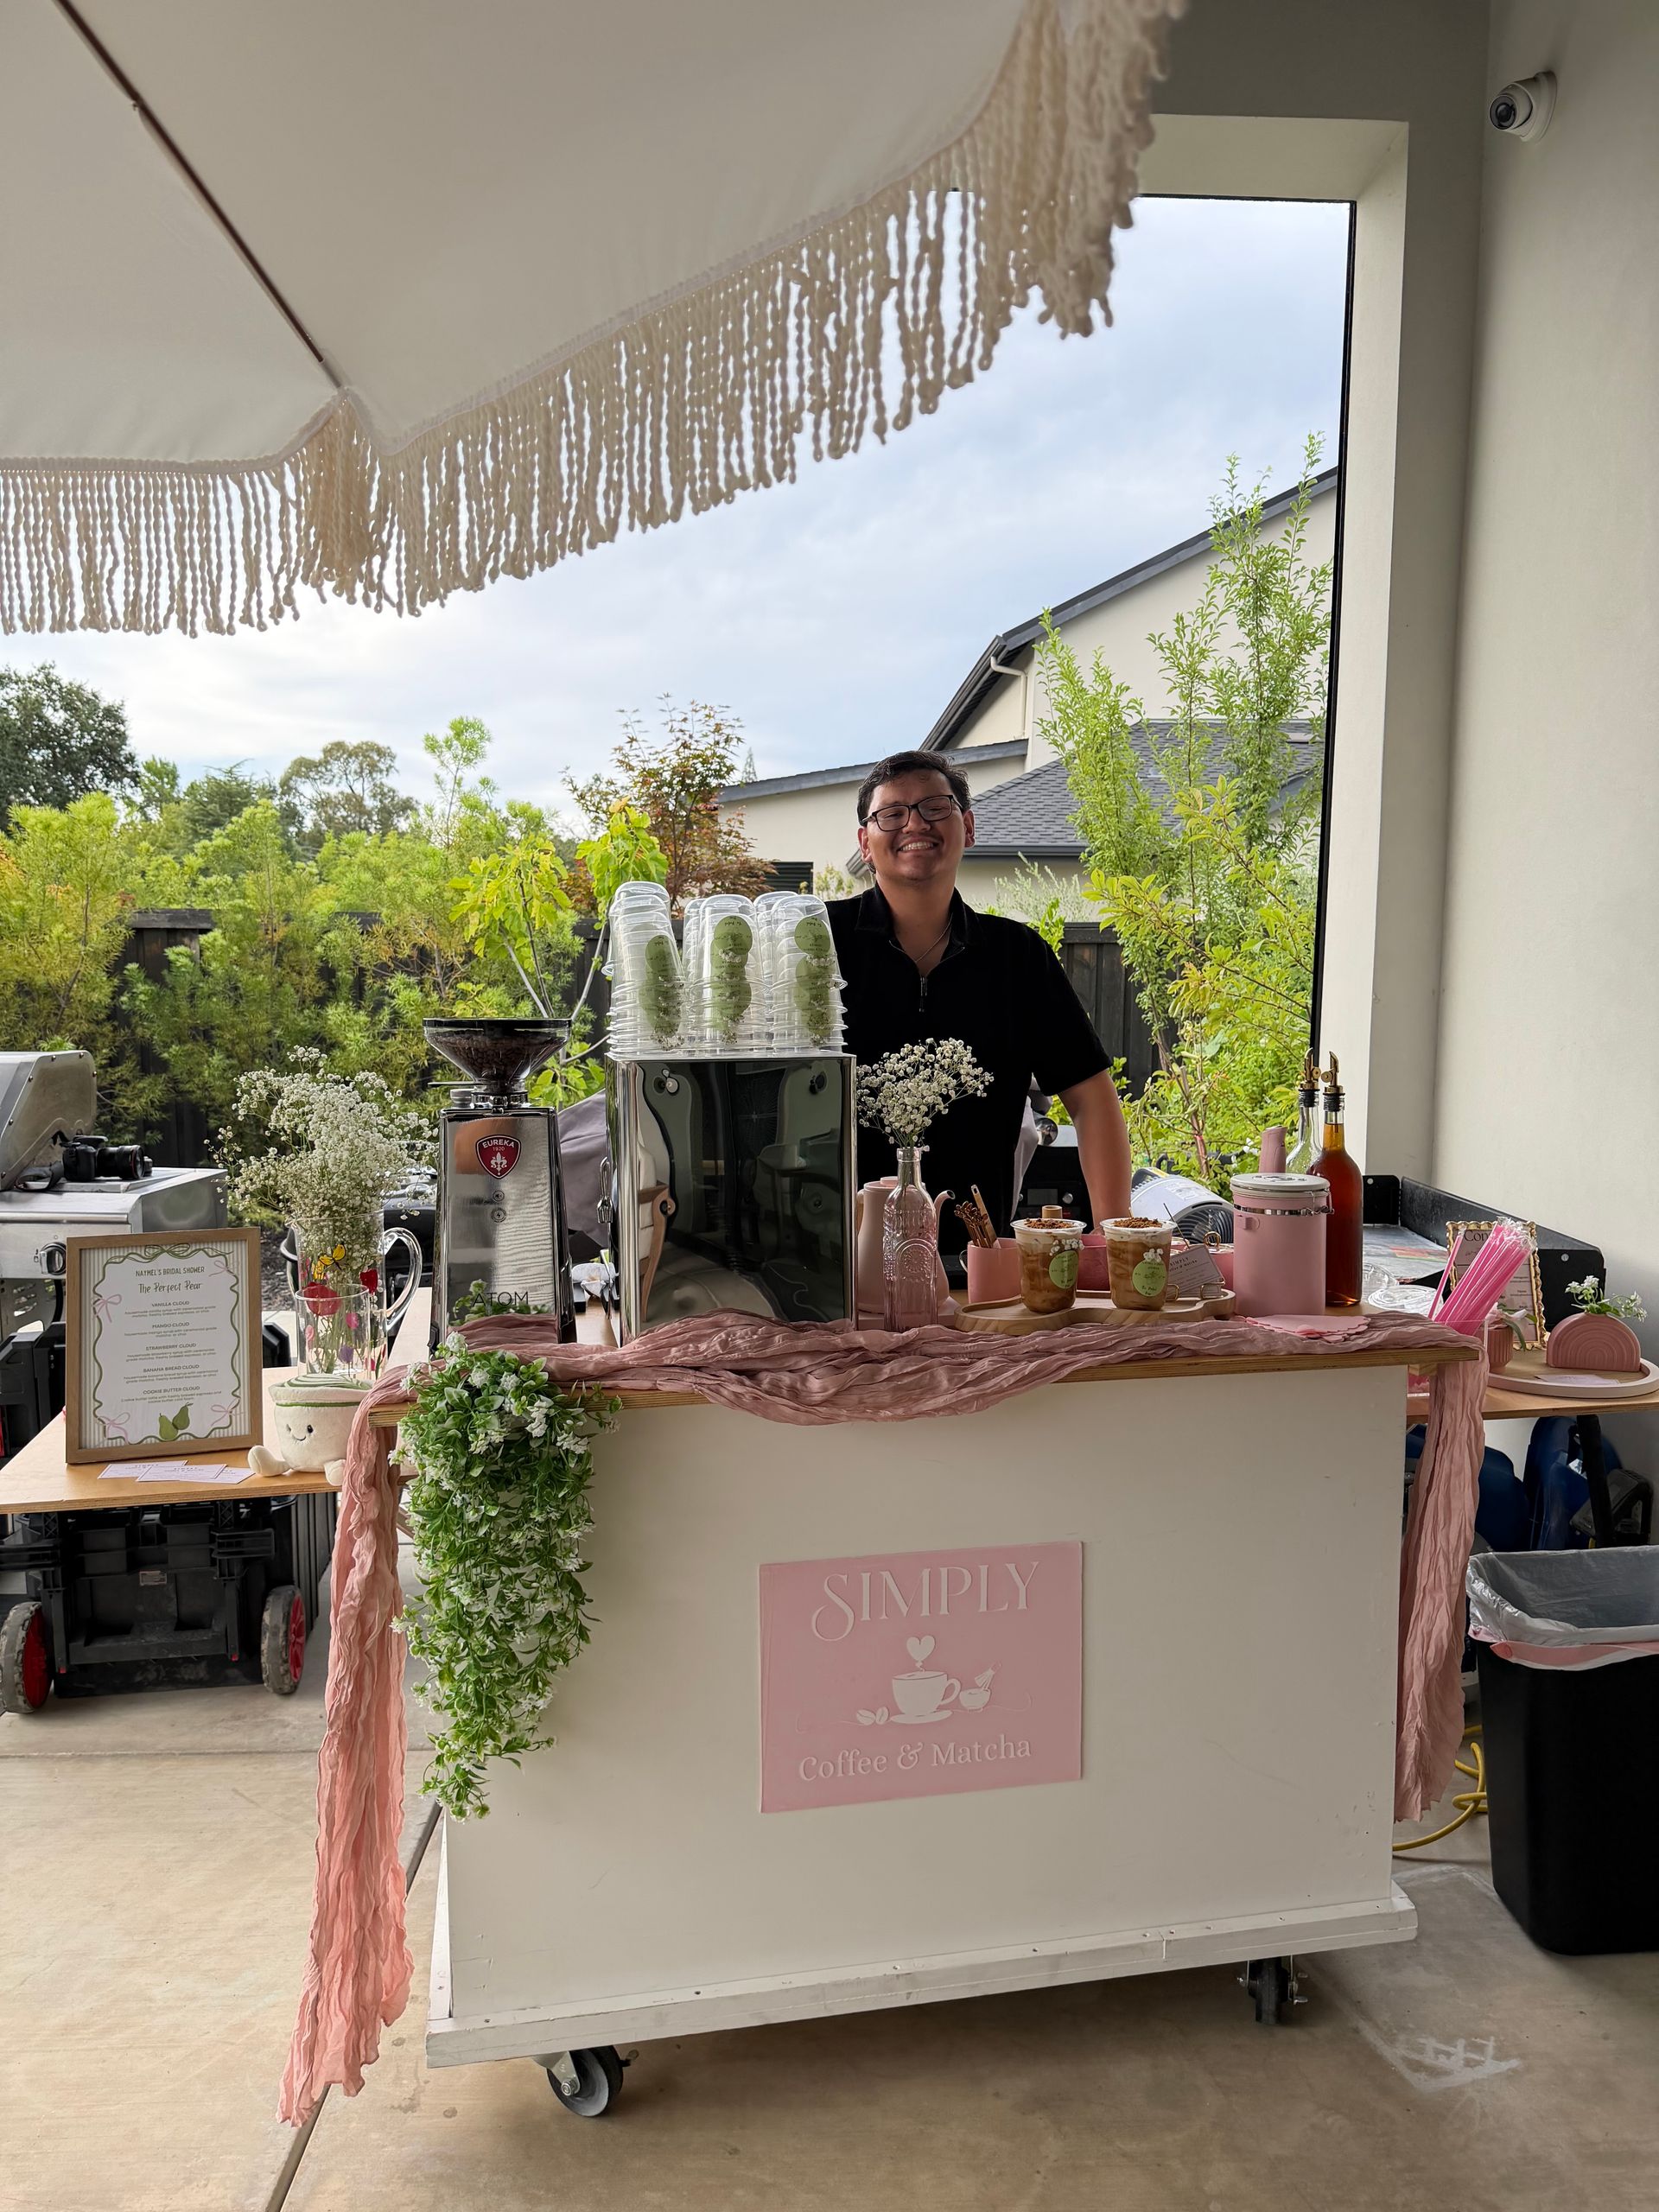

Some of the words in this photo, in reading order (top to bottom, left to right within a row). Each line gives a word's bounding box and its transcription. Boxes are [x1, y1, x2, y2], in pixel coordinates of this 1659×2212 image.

[482, 1139, 515, 1148] EUREKA
[138, 1283, 151, 1294] The
[154, 1281, 181, 1294] Perfect
[184, 1280, 203, 1291] Pear
[473, 1291, 529, 1307] ATOM
[810, 1561, 1039, 1642] SIMPLY
[799, 1748, 887, 1782] Coffee
[897, 1741, 924, 1770] &
[931, 1733, 1033, 1767] Matcha
